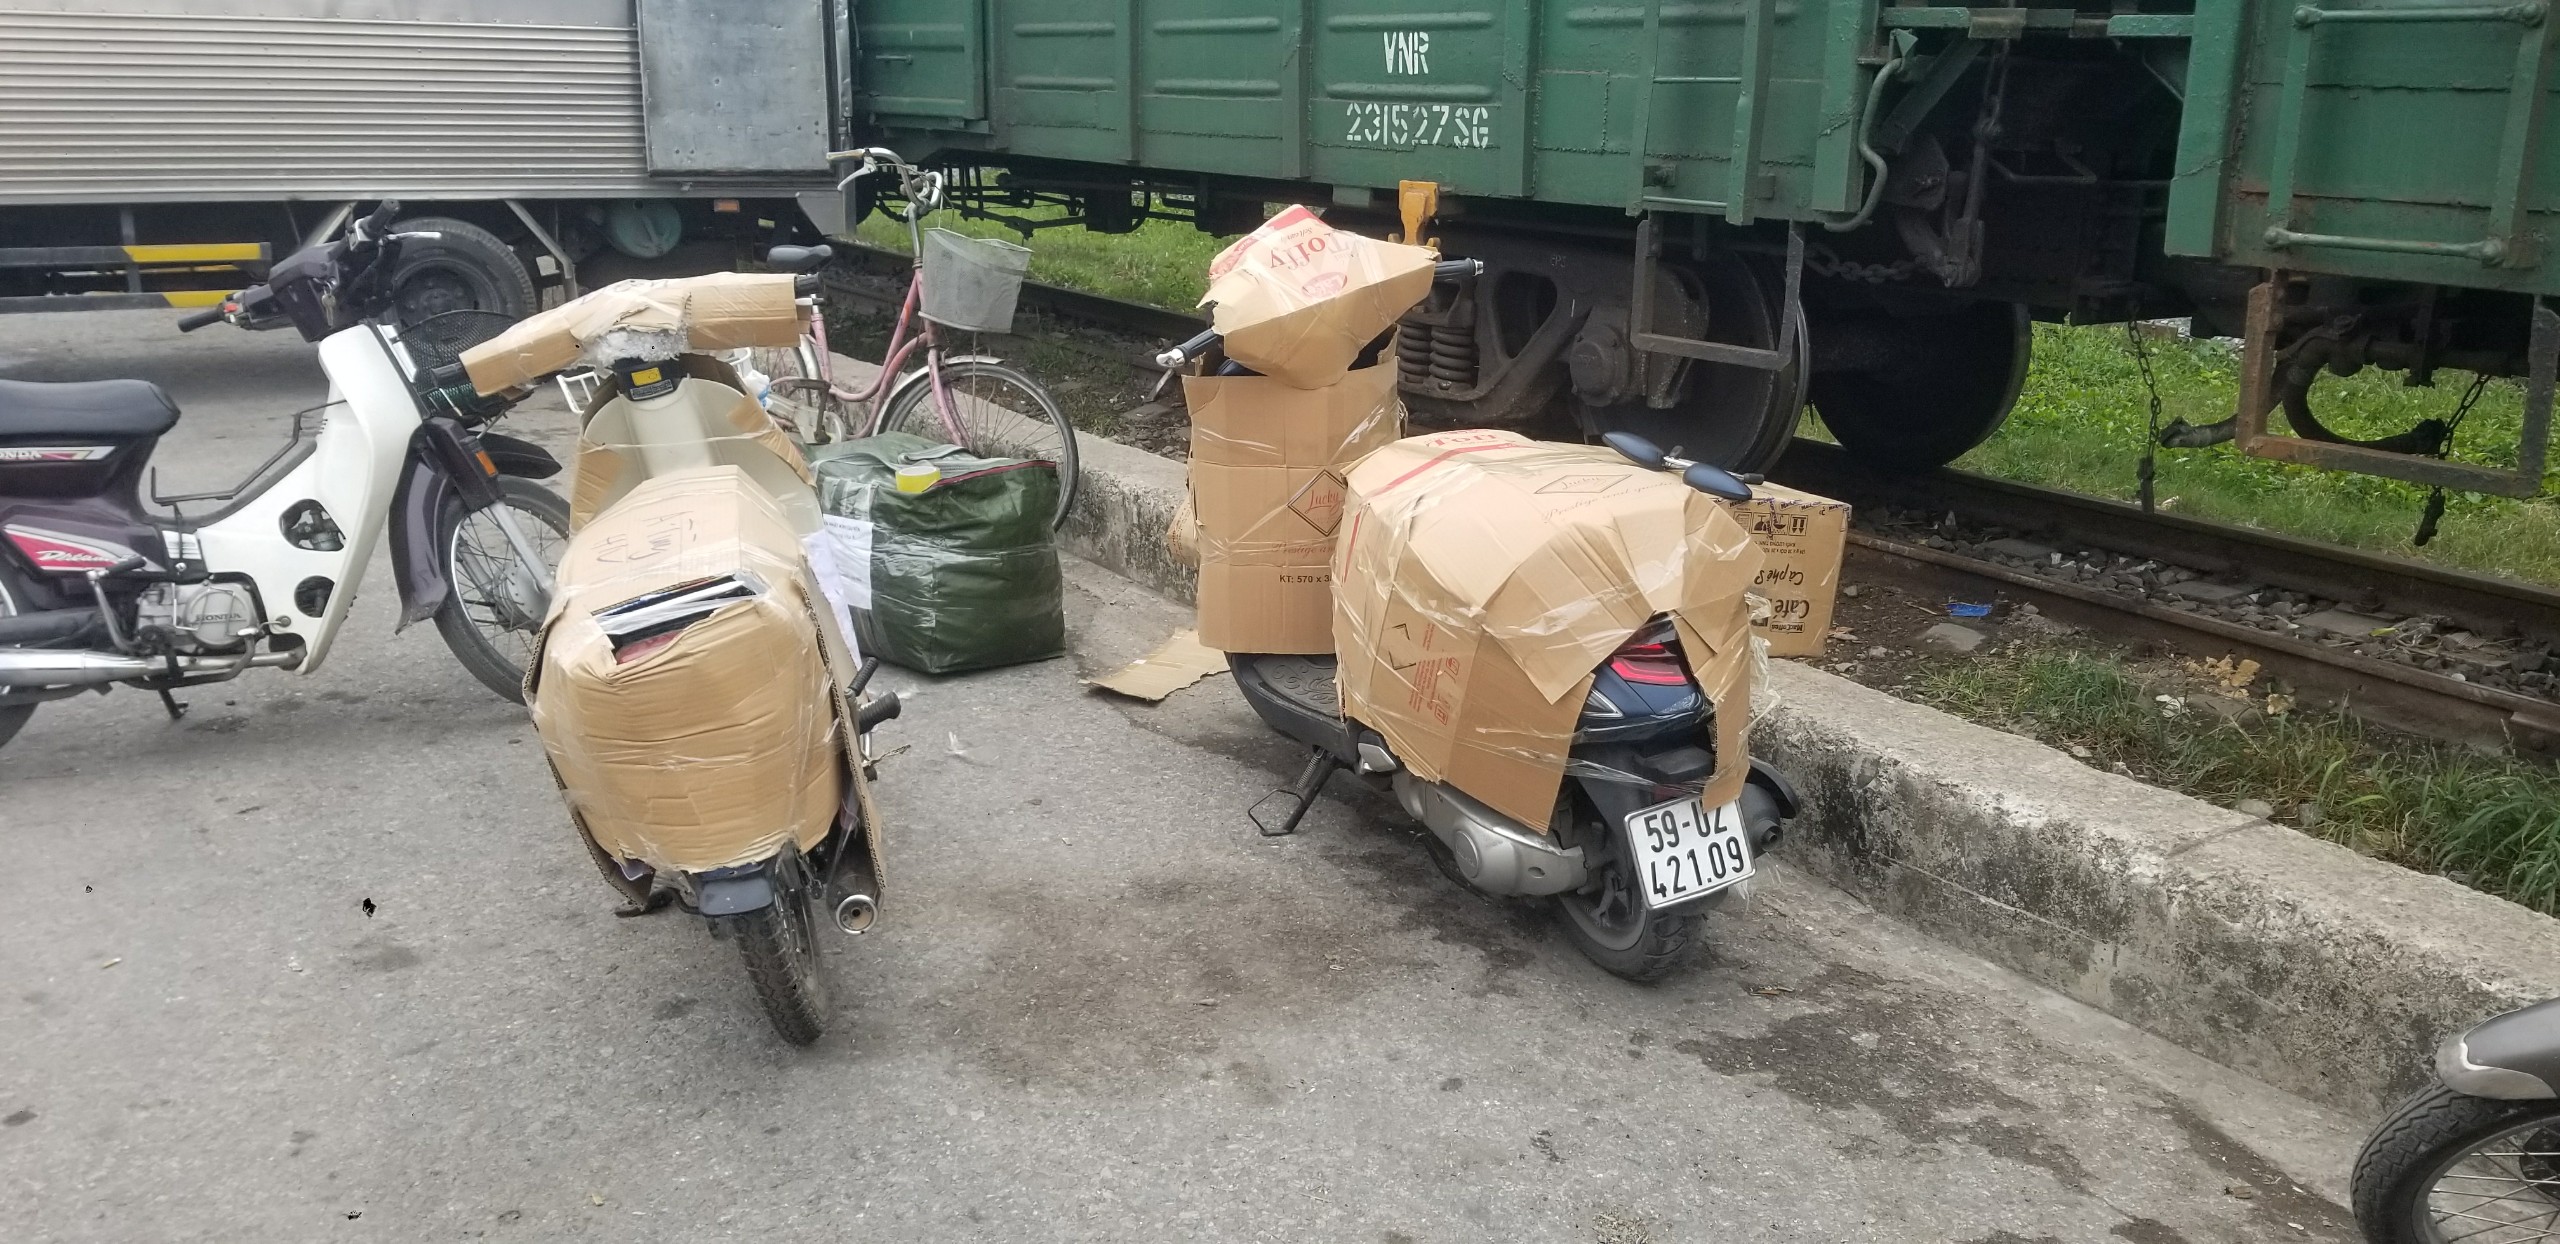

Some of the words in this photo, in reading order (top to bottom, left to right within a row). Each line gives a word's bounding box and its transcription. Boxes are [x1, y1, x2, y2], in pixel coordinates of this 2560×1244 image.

[1383, 31, 1430, 75] VNR
[1346, 102, 1489, 149] 231527SG
[1304, 489, 1342, 517] Lucky
[1279, 574, 1294, 583] KT:
[1297, 575, 1313, 583] 570
[196, 612, 242, 621] HONDA
[1774, 599, 1810, 619] Café
[1643, 801, 1728, 853] 59-U2
[1650, 836, 1744, 898] 421.09
